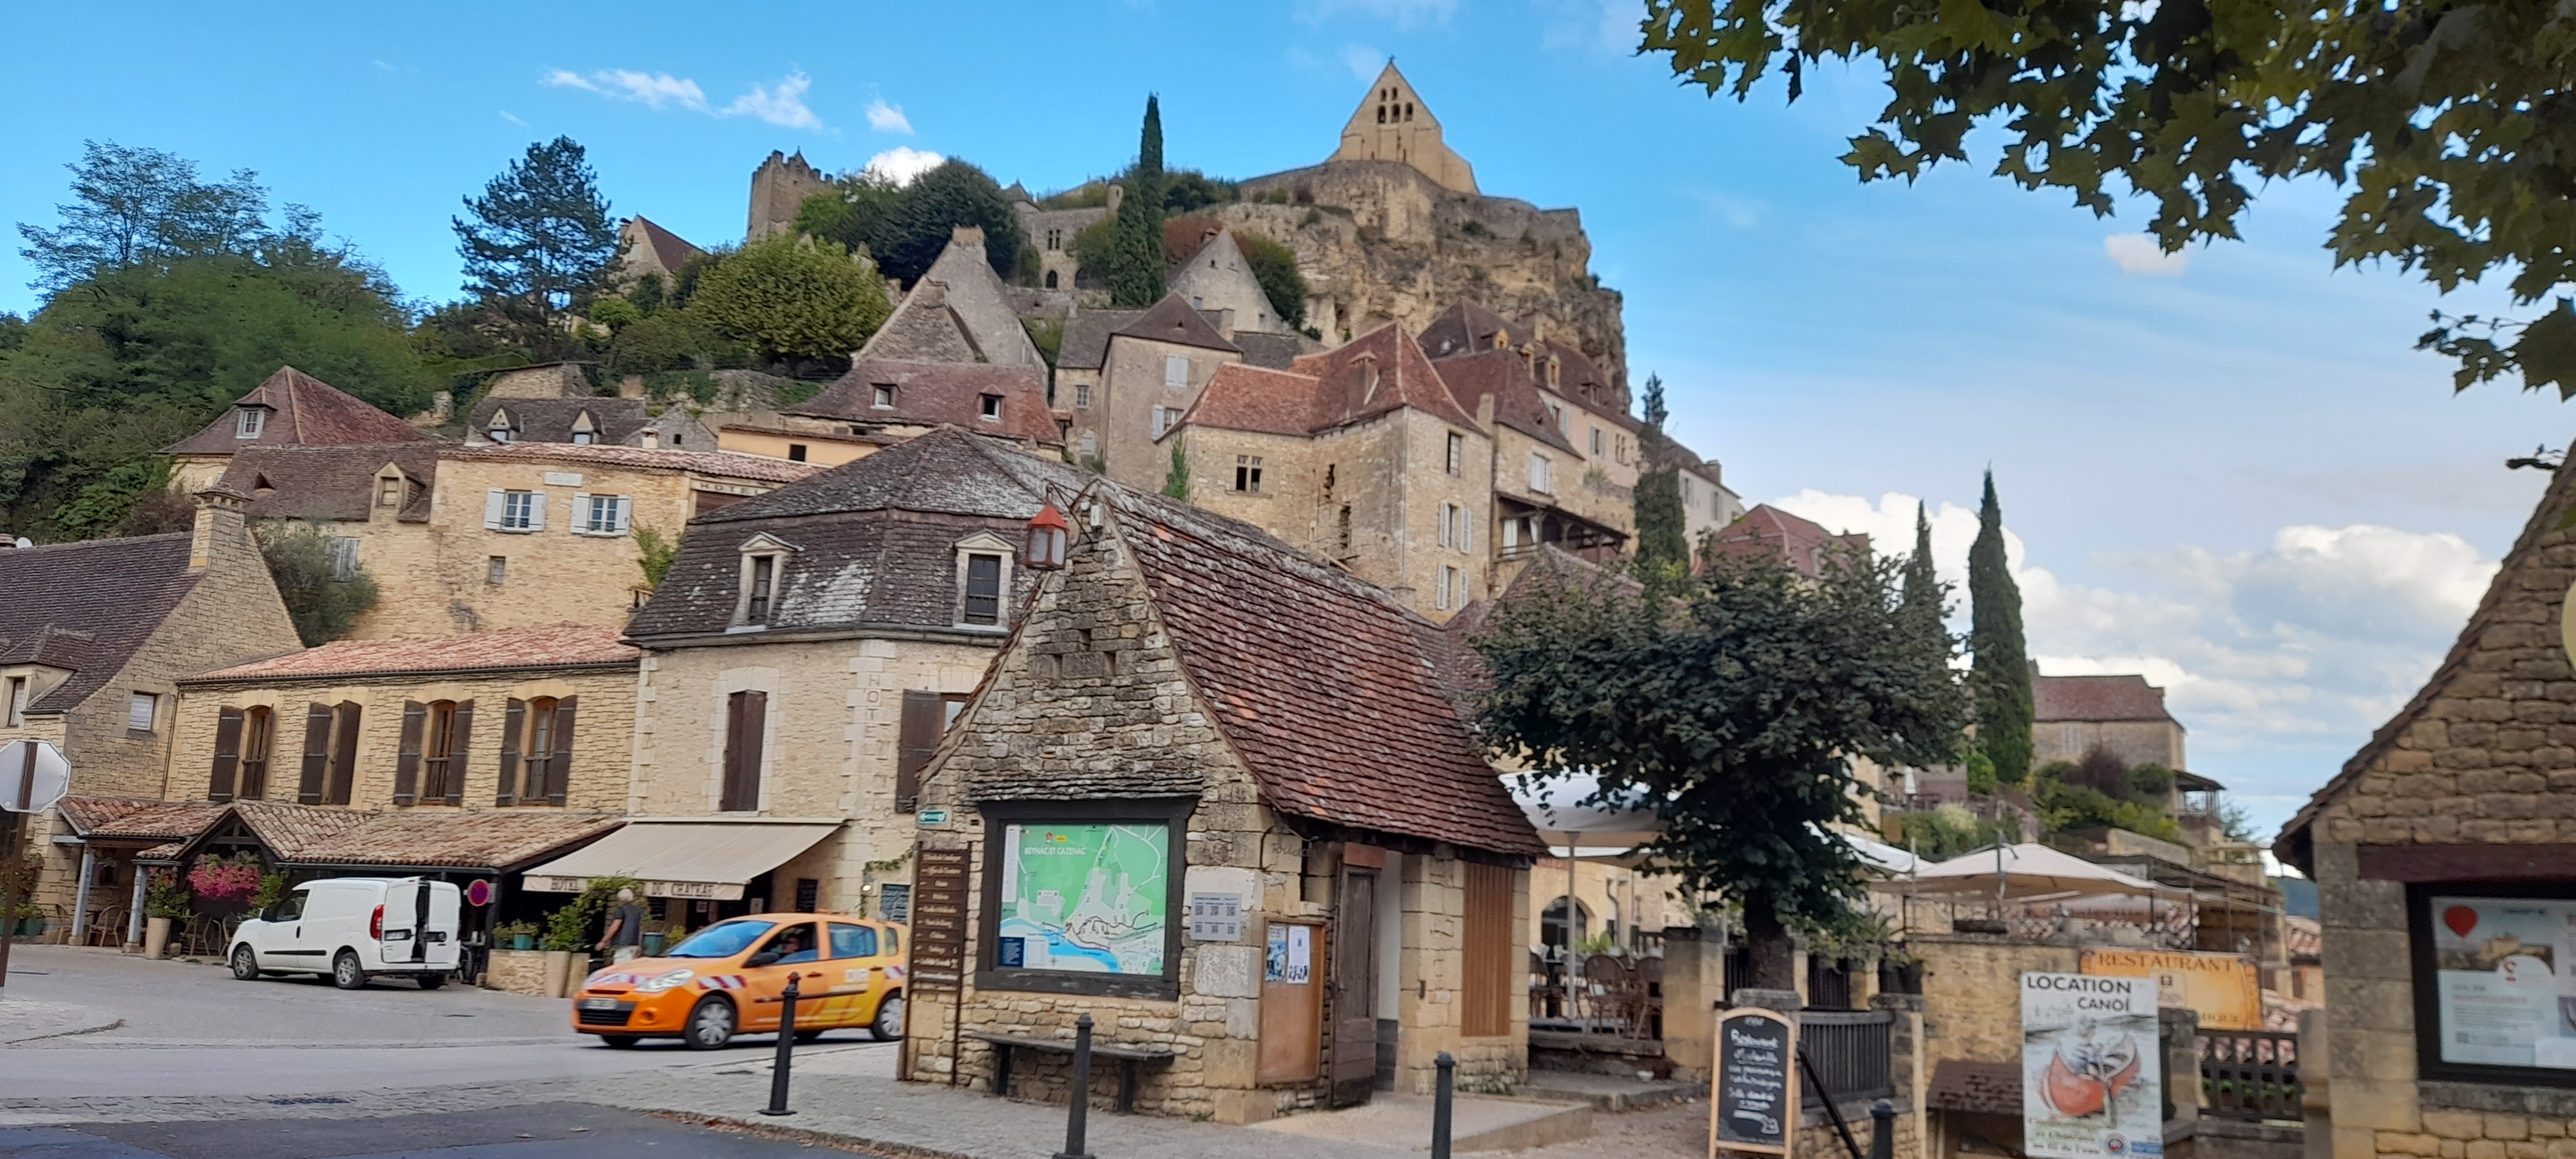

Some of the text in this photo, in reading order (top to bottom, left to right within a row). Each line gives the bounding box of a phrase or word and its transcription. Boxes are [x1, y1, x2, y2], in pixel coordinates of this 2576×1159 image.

[1025, 846, 1086, 855] BEYNAC ET CAZENAC
[551, 878, 579, 890] HOTEL
[2099, 953, 2231, 972] RESTAURANT
[2028, 975, 2131, 994] LOCATION
